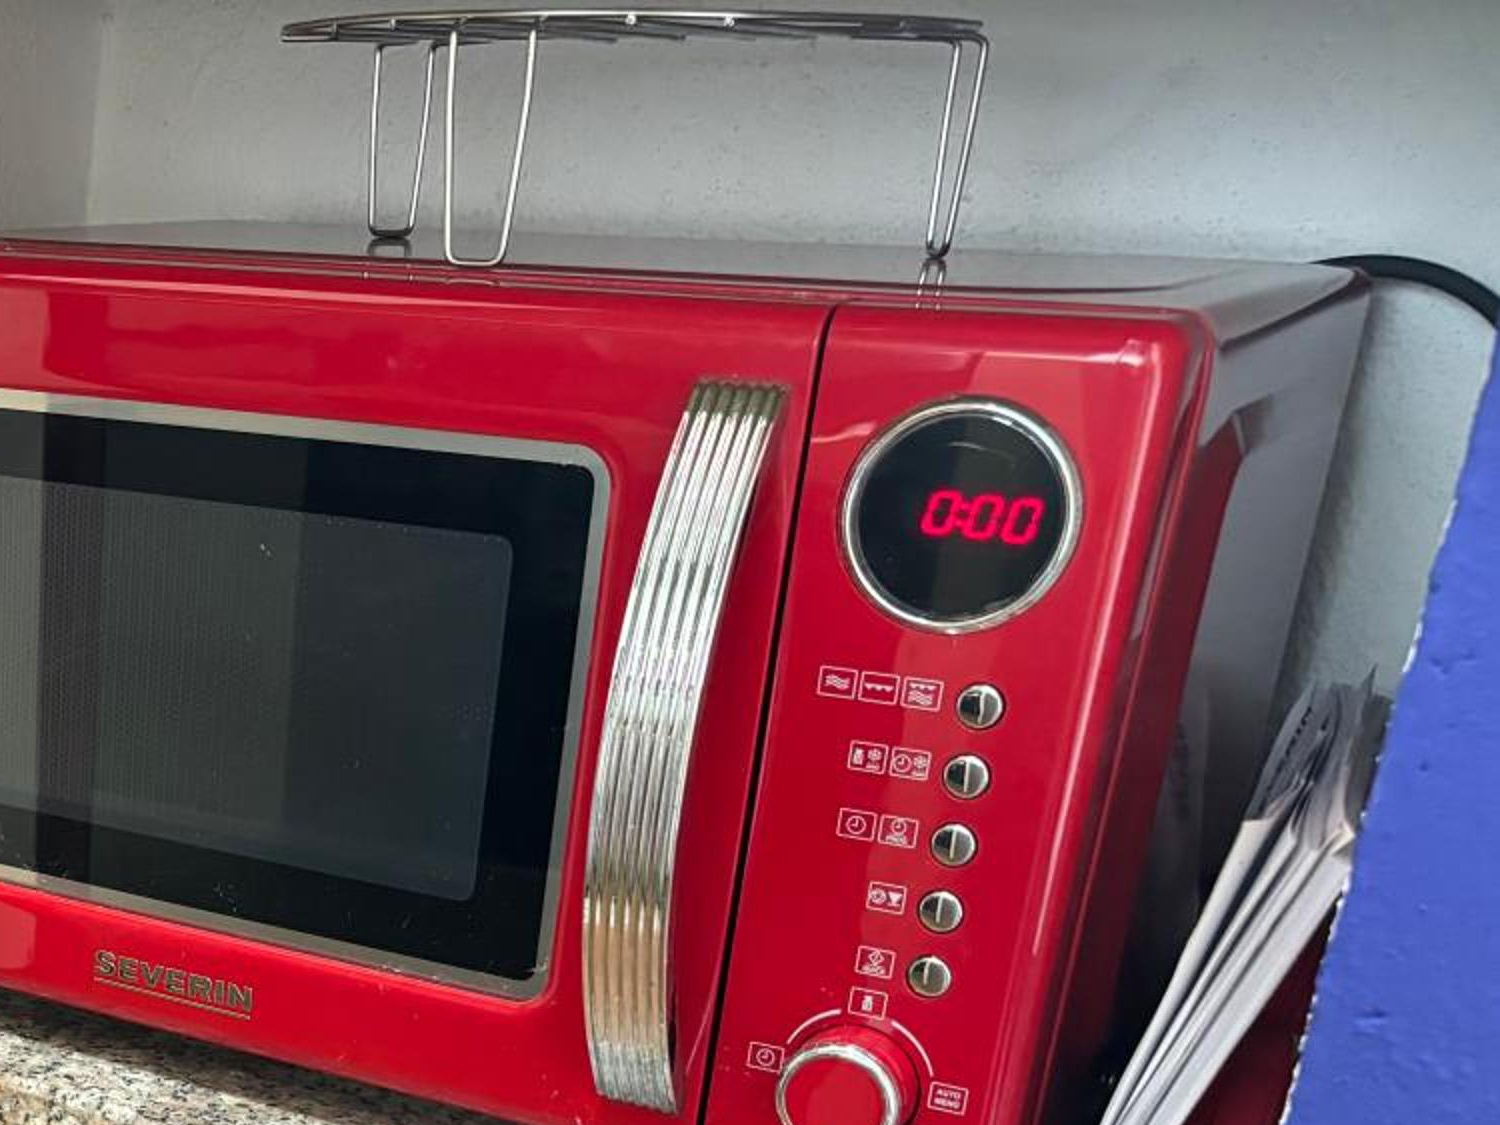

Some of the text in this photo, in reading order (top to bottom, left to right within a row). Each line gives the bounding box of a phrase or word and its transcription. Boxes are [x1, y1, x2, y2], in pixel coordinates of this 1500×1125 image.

[920, 489, 1045, 545] 0:00
[94, 949, 253, 1012] SEVERIN
[936, 1088, 961, 1100] AUTO
